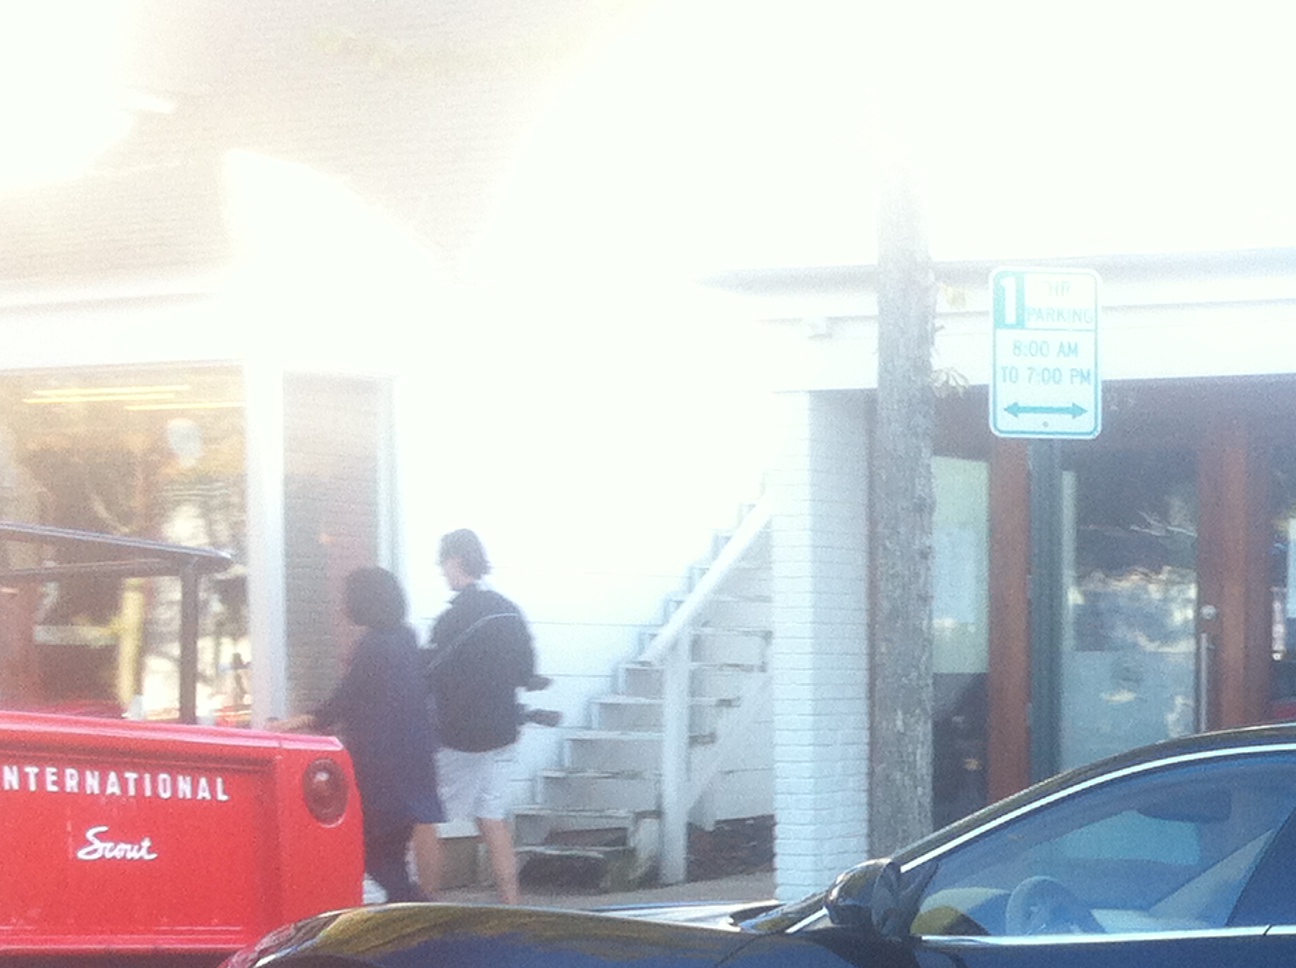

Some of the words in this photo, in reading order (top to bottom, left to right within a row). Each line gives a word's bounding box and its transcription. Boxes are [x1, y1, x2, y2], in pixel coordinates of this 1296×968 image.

[1027, 307, 1094, 325] PARKING
[1012, 339, 1050, 358] 8:00
[1056, 341, 1079, 359] AM
[1000, 365, 1019, 384] TO
[1026, 367, 1063, 385] 7:00
[1069, 368, 1092, 386] PM
[76, 825, 158, 861] Scout
